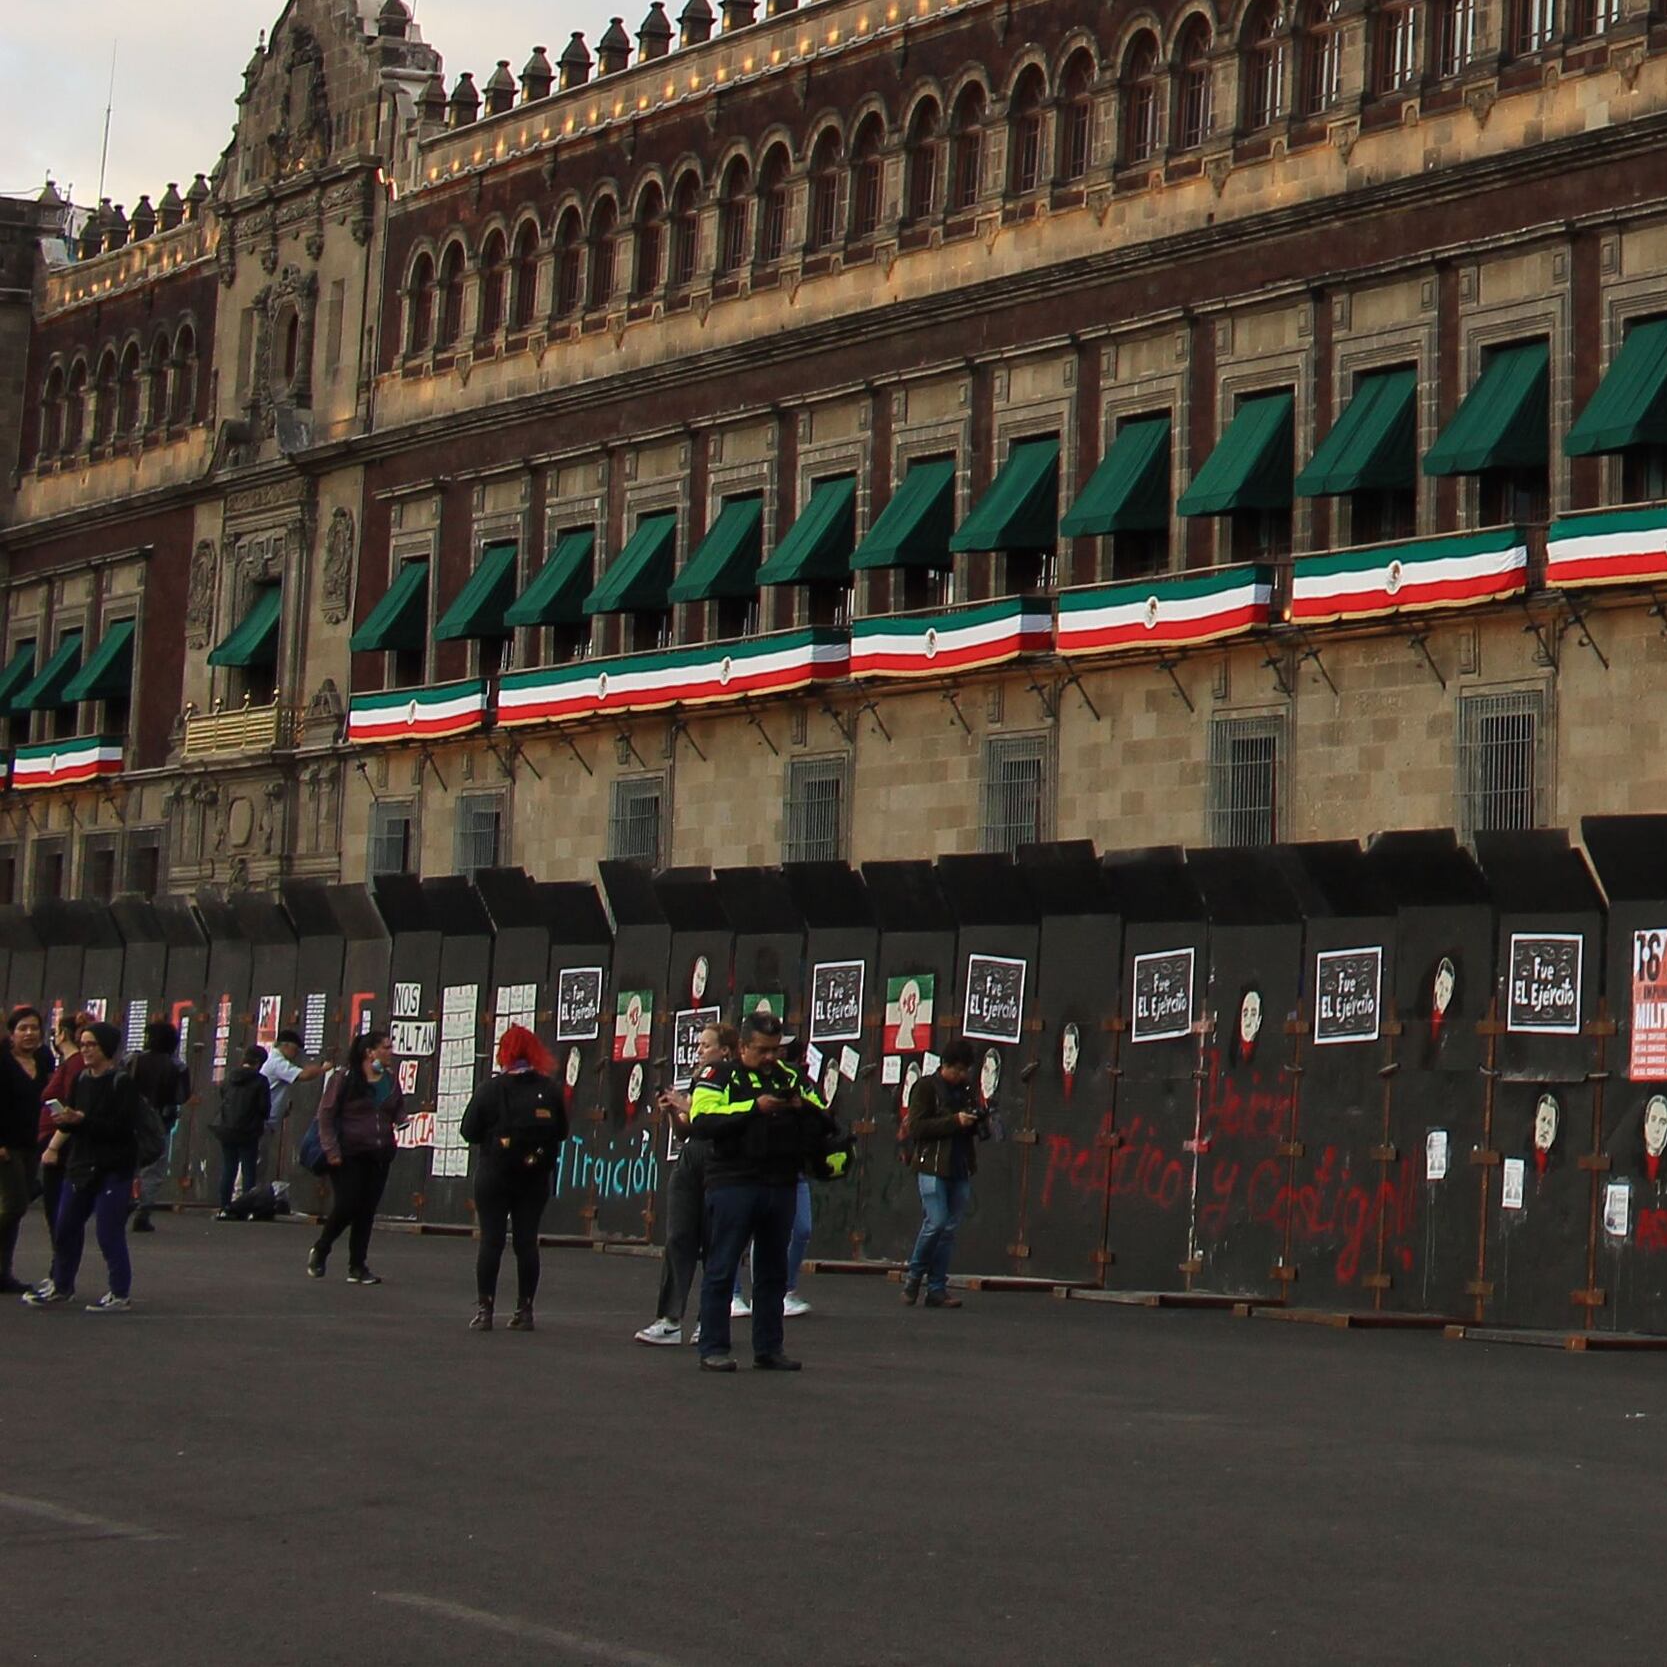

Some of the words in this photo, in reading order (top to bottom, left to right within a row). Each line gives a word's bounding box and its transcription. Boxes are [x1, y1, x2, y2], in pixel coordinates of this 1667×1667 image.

[1534, 956, 1554, 980] Fue
[1637, 933, 1661, 982] 16
[1338, 972, 1356, 994] Fue
[1515, 980, 1528, 1004] EL
[394, 986, 419, 1014] NOS
[1322, 995, 1333, 1018] EL
[392, 1024, 435, 1052] FALTAN
[399, 1063, 416, 1090] 43
